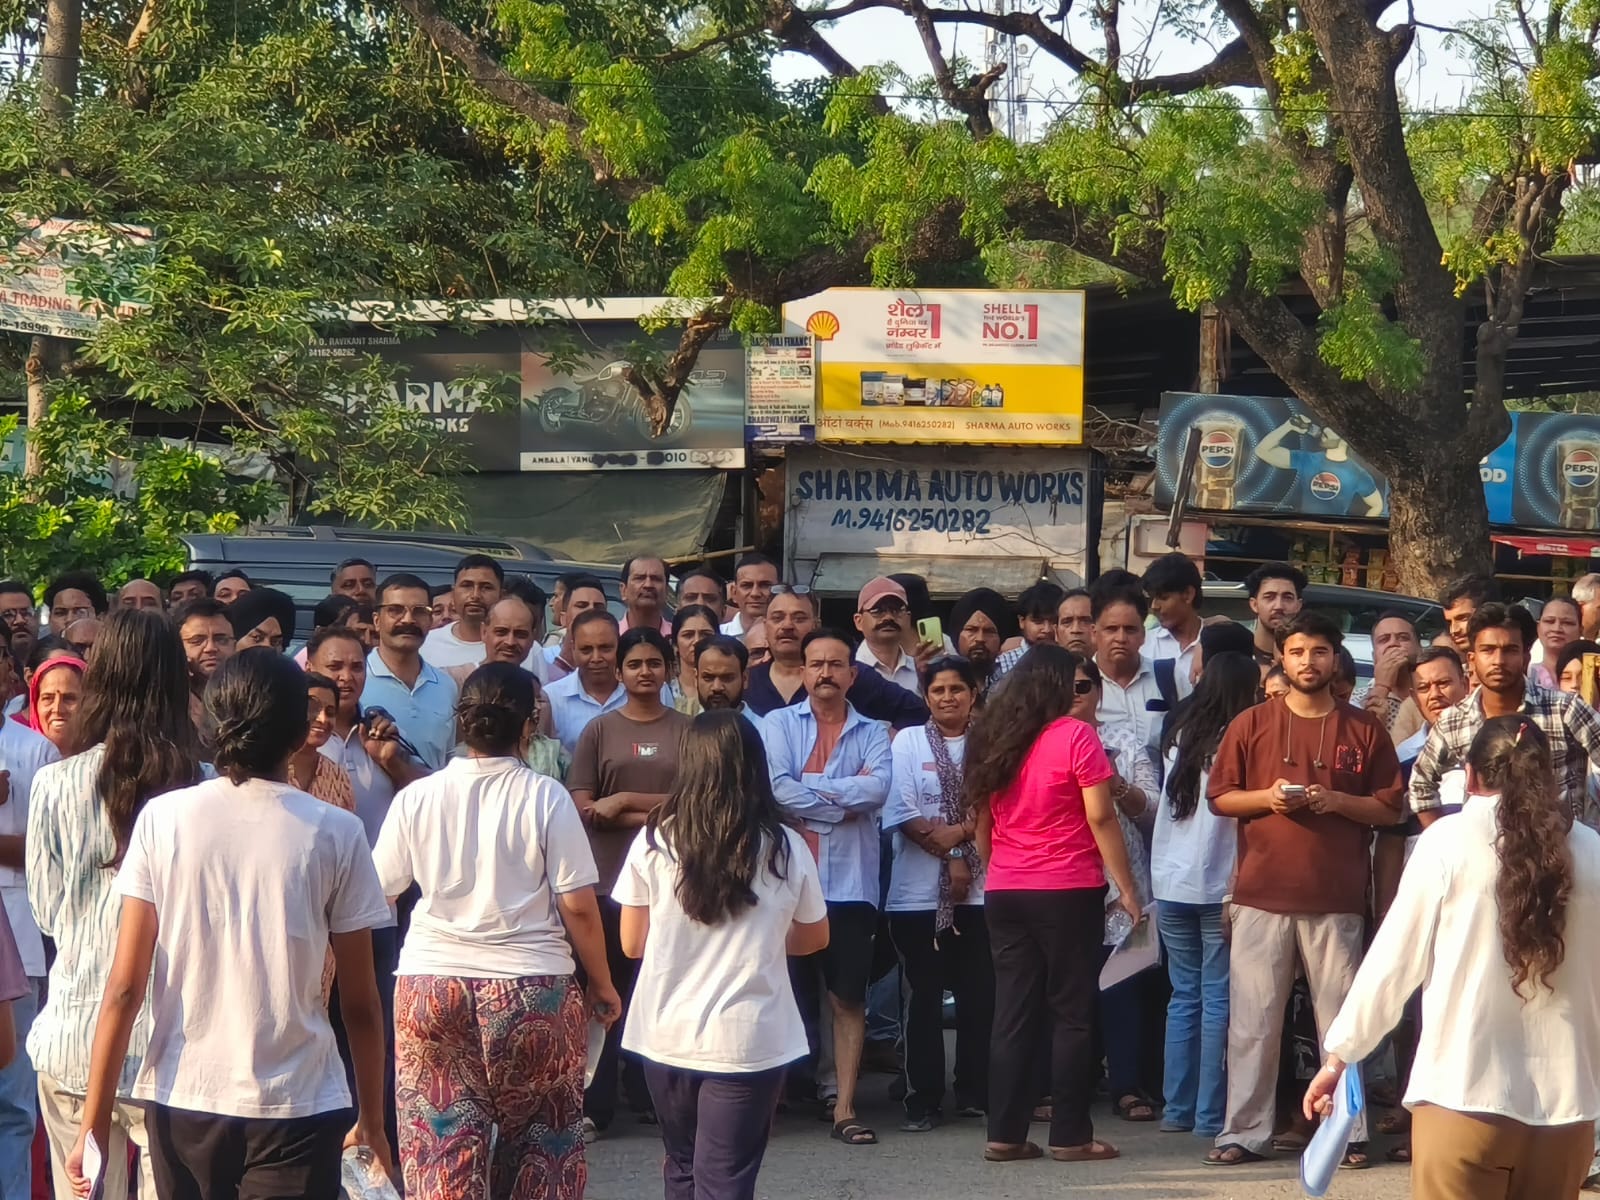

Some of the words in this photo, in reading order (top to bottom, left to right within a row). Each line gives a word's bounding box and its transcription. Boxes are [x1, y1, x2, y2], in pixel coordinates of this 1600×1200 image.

[12, 292, 72, 311] TRADING
[887, 298, 927, 318] शैल
[983, 303, 1021, 314] SHELL
[982, 322, 1025, 340] NO.
[329, 337, 365, 345] RAVIKANT
[367, 337, 401, 345] SHARMA
[965, 421, 1005, 431] SHARMA
[1007, 421, 1034, 431] AUTO
[1036, 421, 1071, 431] WORKS
[1201, 445, 1234, 455] PEPSI
[532, 456, 565, 464] AMBALA
[1565, 463, 1598, 474] PEPSI
[796, 469, 922, 501] SHARMA
[928, 470, 993, 502] AUTO
[998, 471, 1084, 505] WORKS
[1312, 480, 1338, 492] PEPSI
[831, 507, 990, 534] M.9416250282
